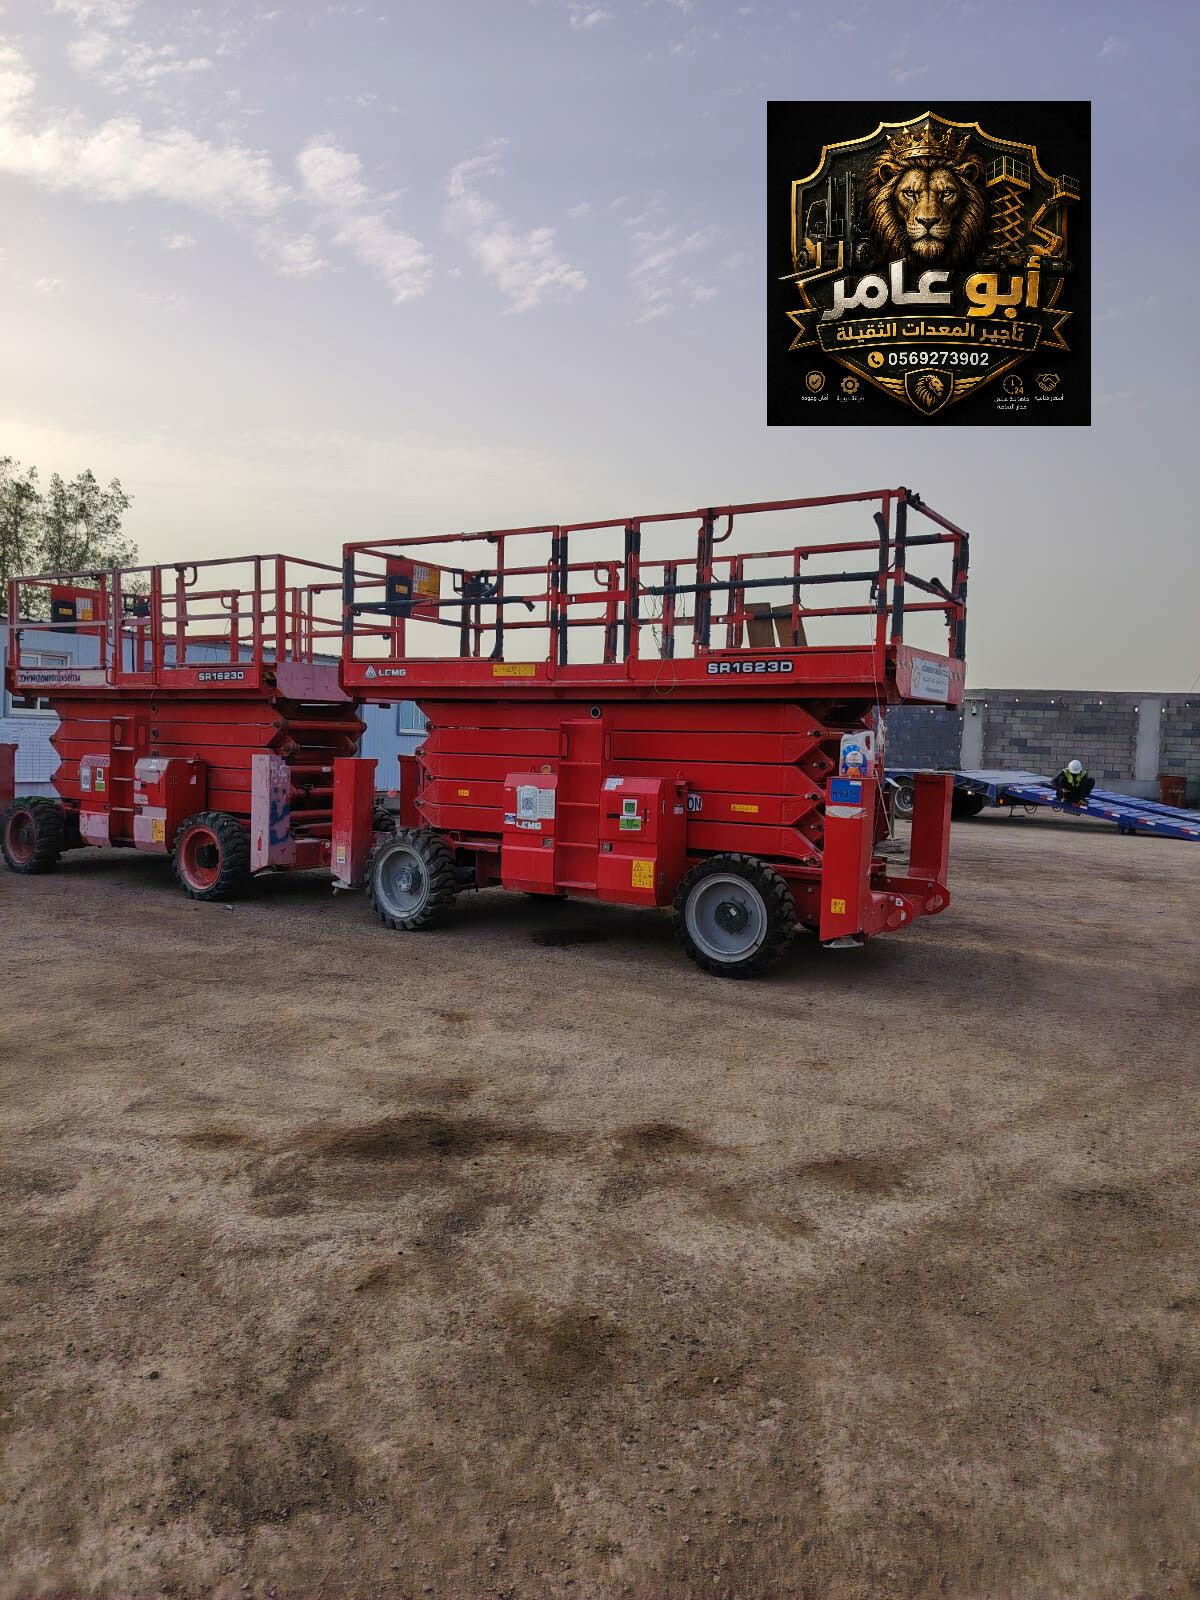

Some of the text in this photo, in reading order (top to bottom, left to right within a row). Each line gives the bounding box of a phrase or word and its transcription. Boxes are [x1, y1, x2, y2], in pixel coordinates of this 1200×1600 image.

[378, 667, 407, 677] LCMG
[707, 661, 794, 674] SR1623D
[198, 671, 244, 681] SR1623D
